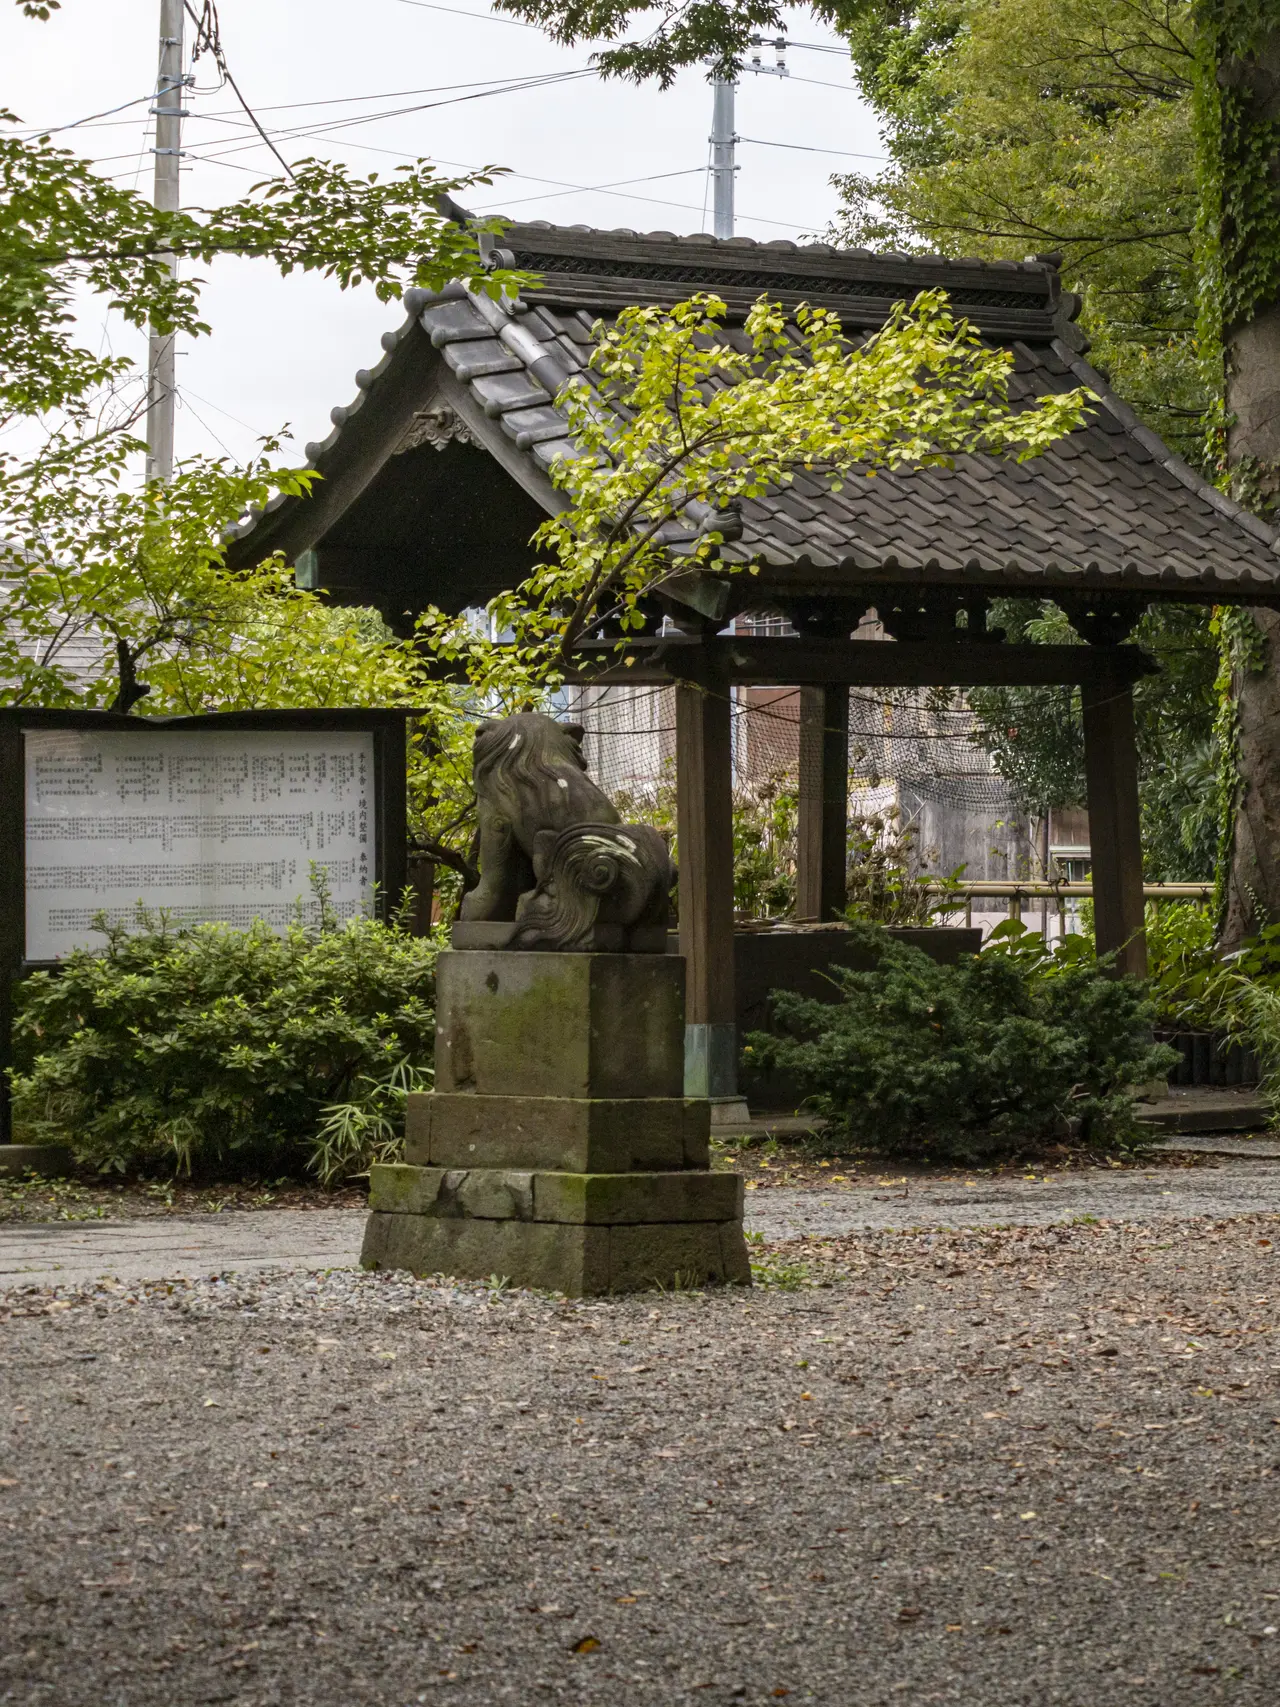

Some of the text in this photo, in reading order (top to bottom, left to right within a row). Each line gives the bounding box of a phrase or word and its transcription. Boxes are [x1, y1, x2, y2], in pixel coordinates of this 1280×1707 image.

[357, 752, 368, 845] 手水舎・境内整備
[358, 851, 368, 887] 奉納者
